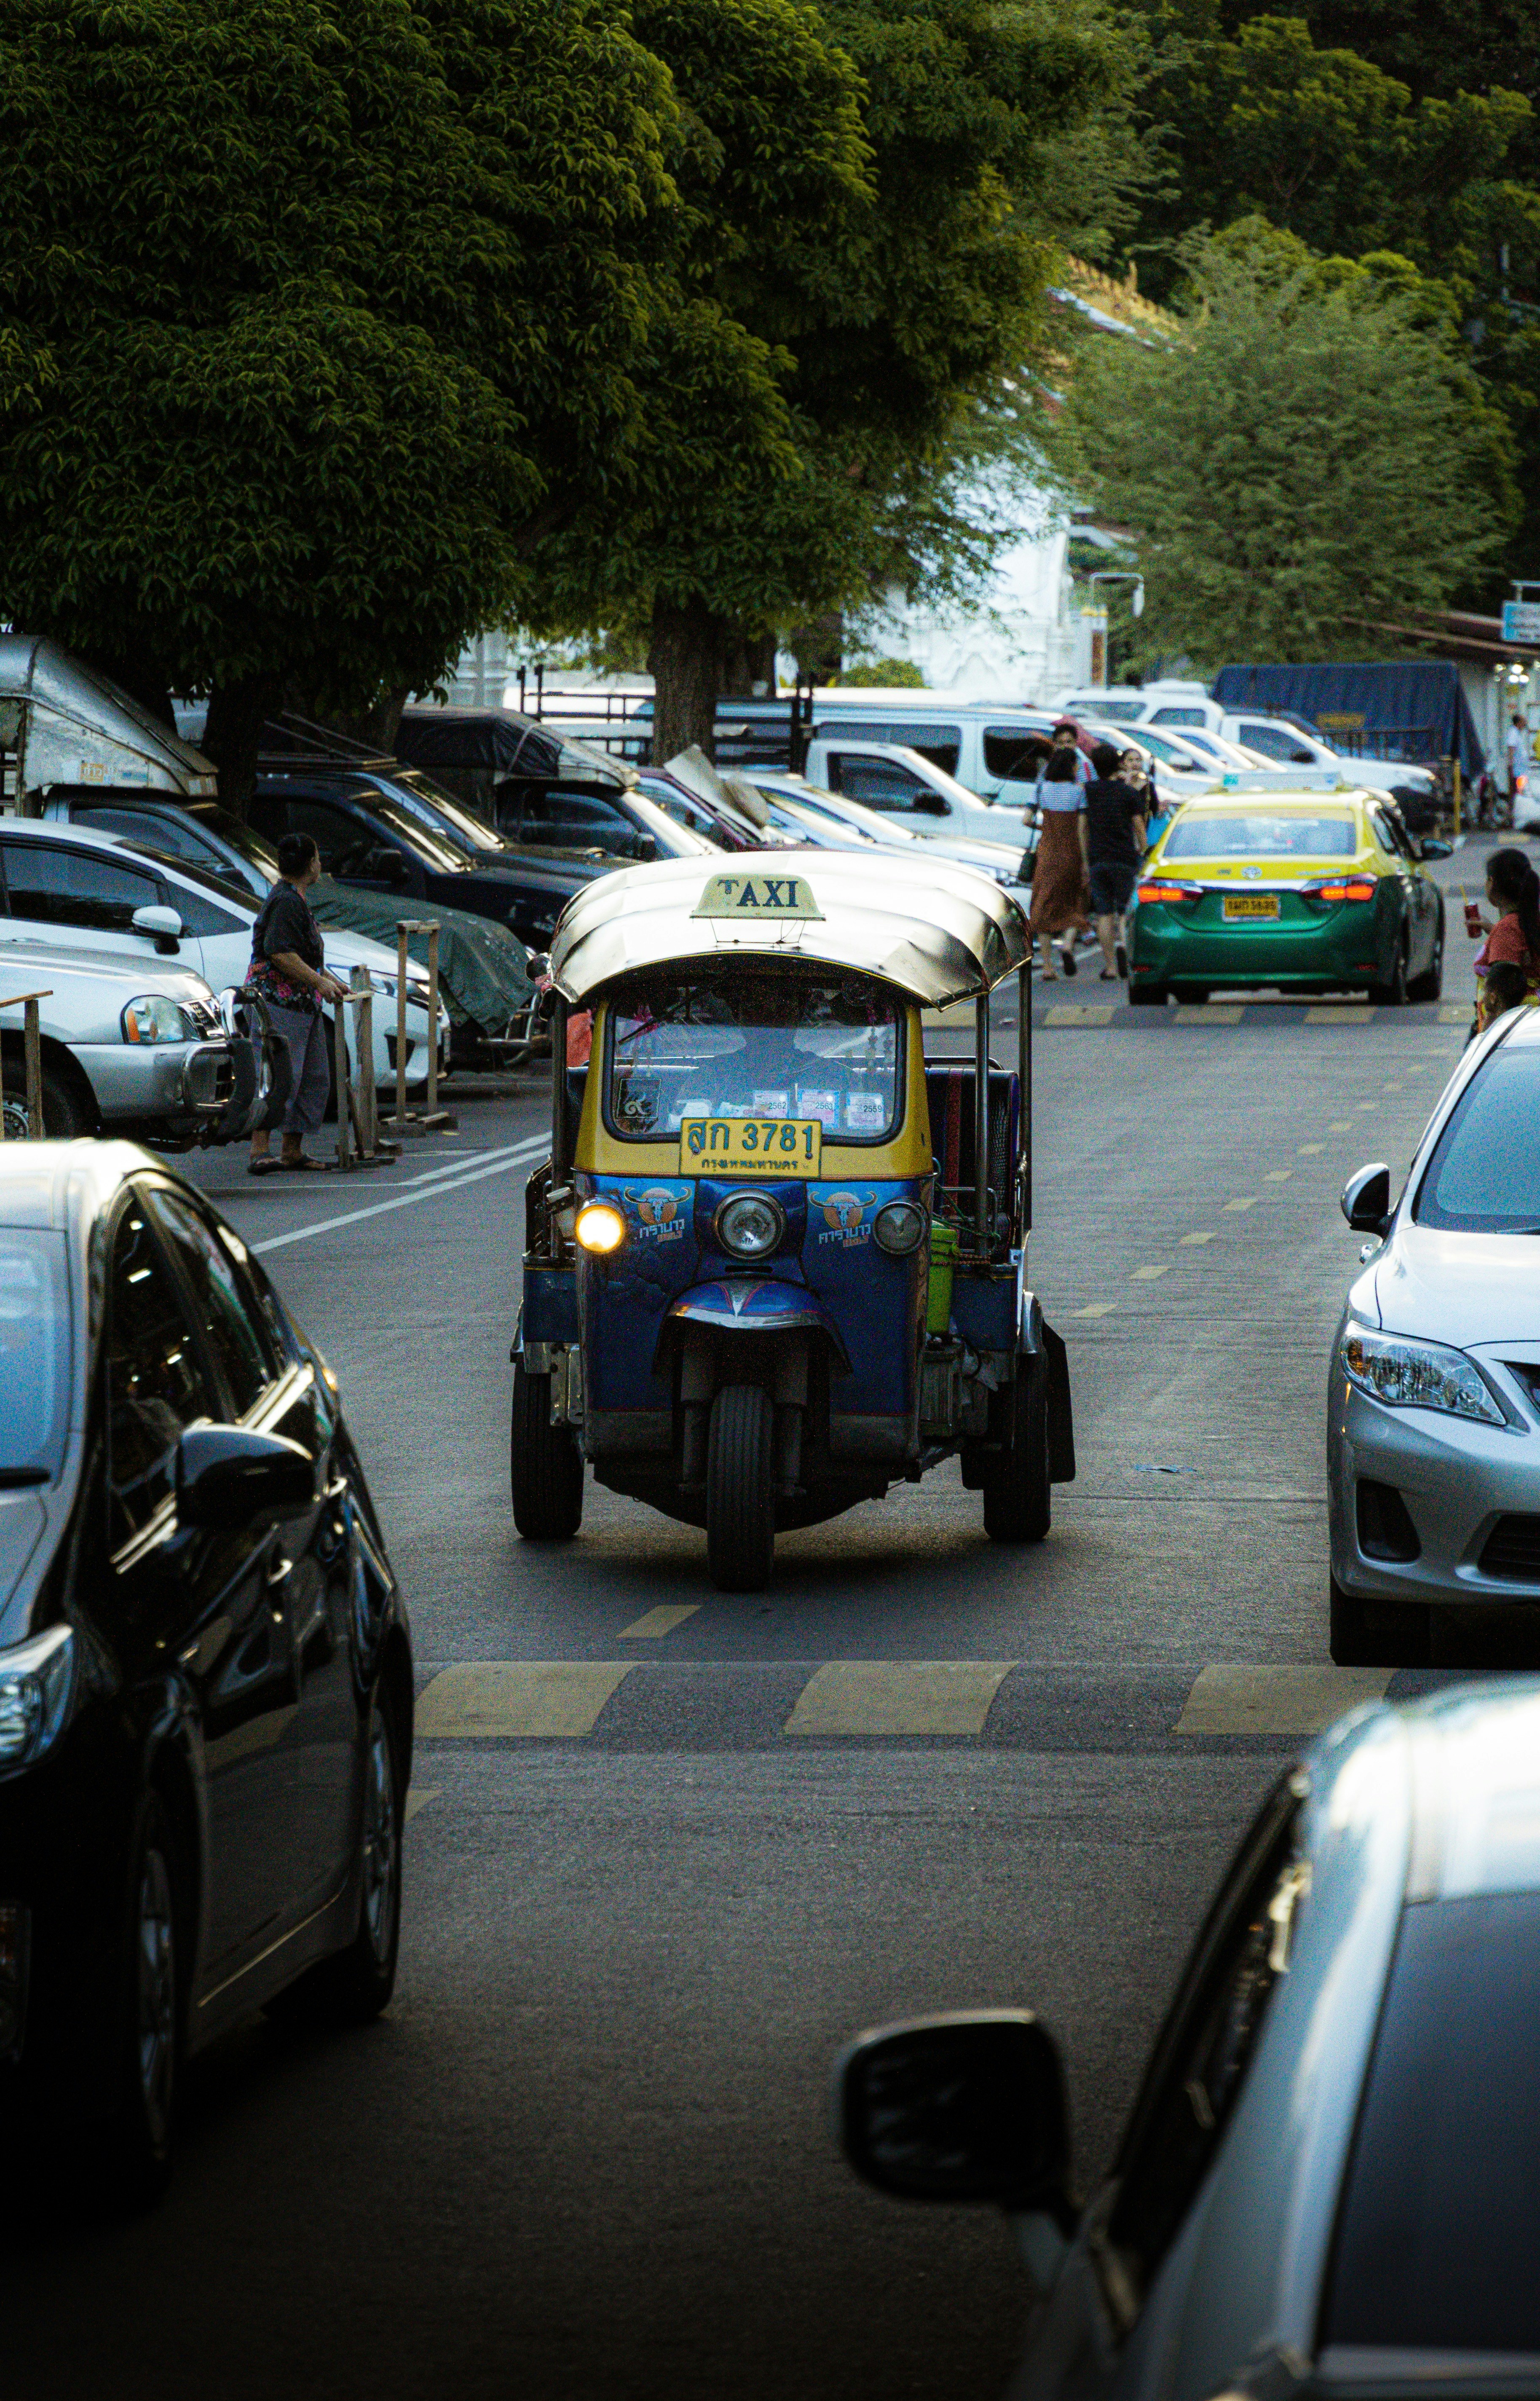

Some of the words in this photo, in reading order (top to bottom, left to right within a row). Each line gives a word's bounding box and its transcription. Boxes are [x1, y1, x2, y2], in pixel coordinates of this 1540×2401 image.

[717, 879, 799, 907] TAXI
[769, 1101, 786, 1109] 2562
[816, 1102, 833, 1110] 2563
[688, 1121, 730, 1152] สก
[742, 1123, 812, 1152] 3781
[702, 1159, 798, 1171] กรุงเทพมหานคร
[819, 1223, 871, 1245] คาราบาว
